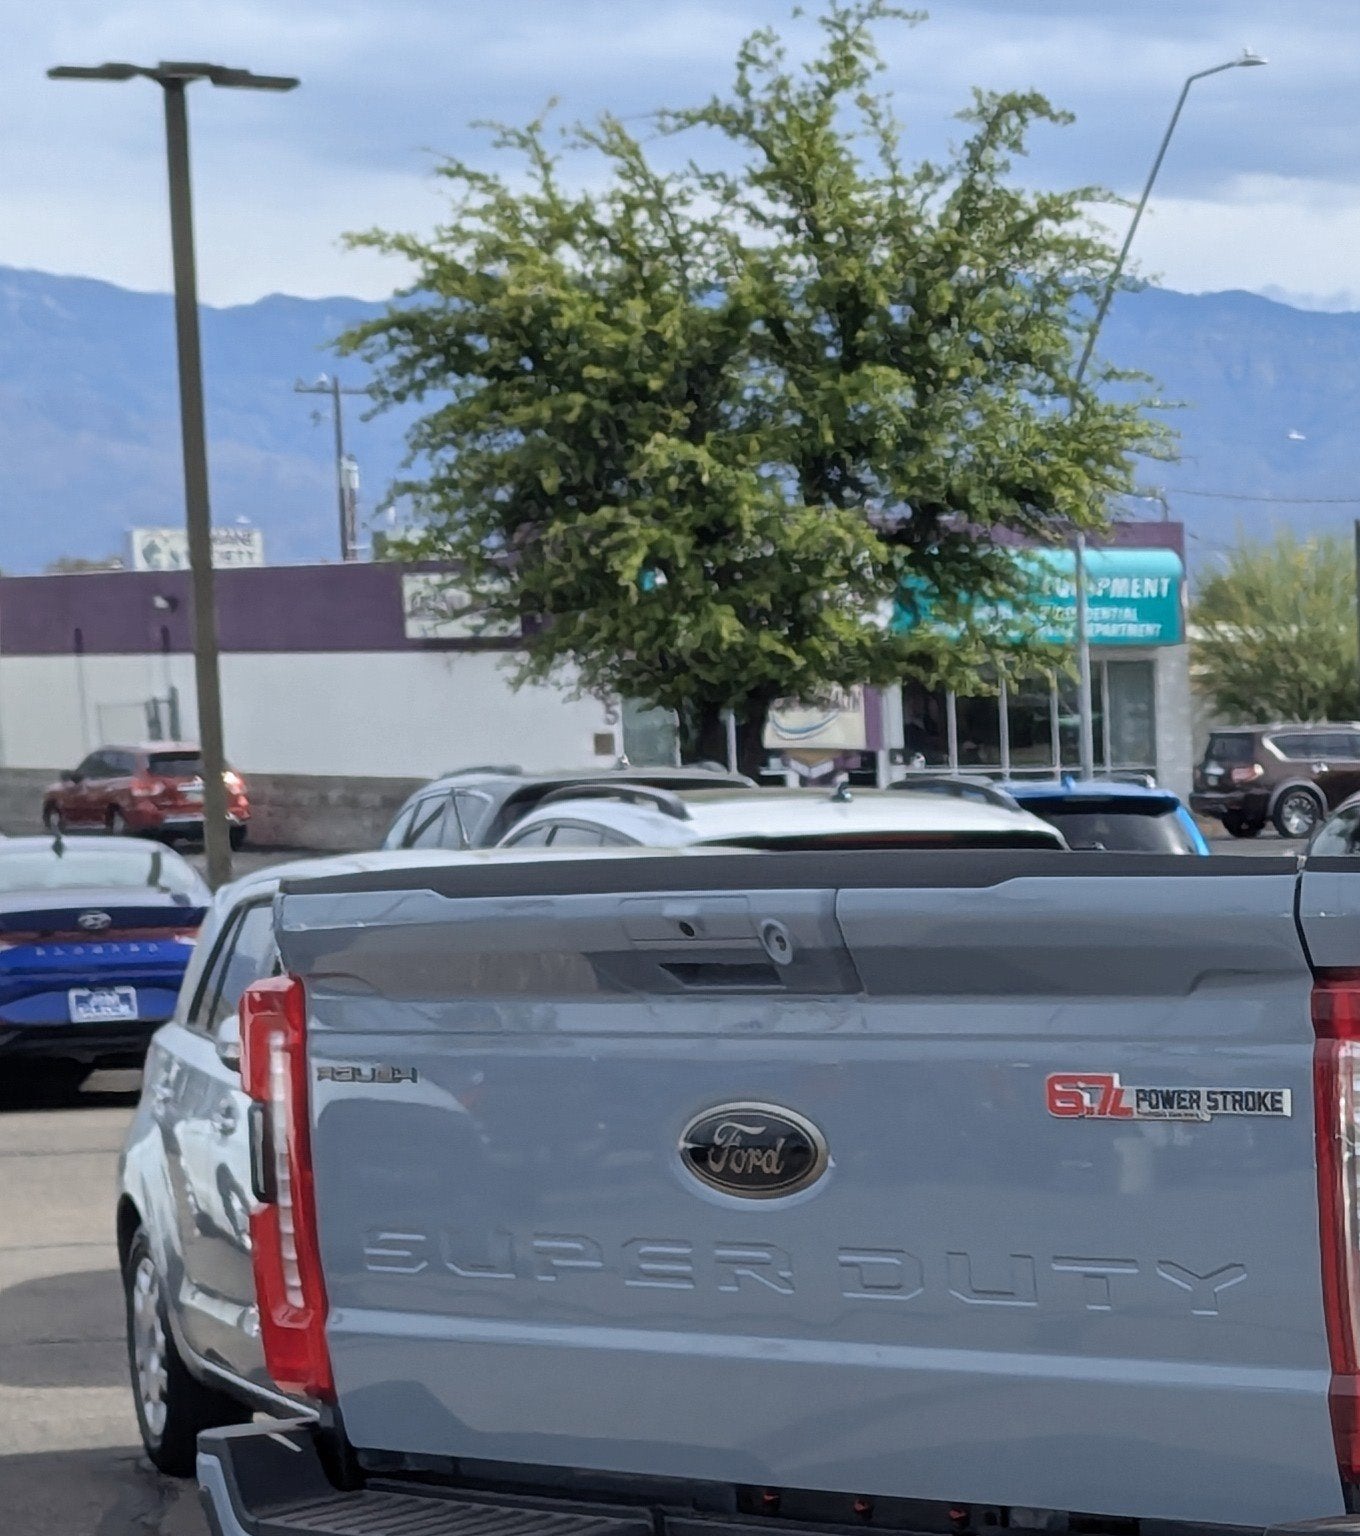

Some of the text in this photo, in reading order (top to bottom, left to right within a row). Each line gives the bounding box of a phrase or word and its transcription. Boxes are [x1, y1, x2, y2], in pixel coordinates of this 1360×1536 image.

[1135, 1089, 1201, 1110] POWER
[1206, 1090, 1284, 1112] STROKE
[707, 1121, 786, 1175] Ford
[363, 1226, 1248, 1316] SUPER DUTY
